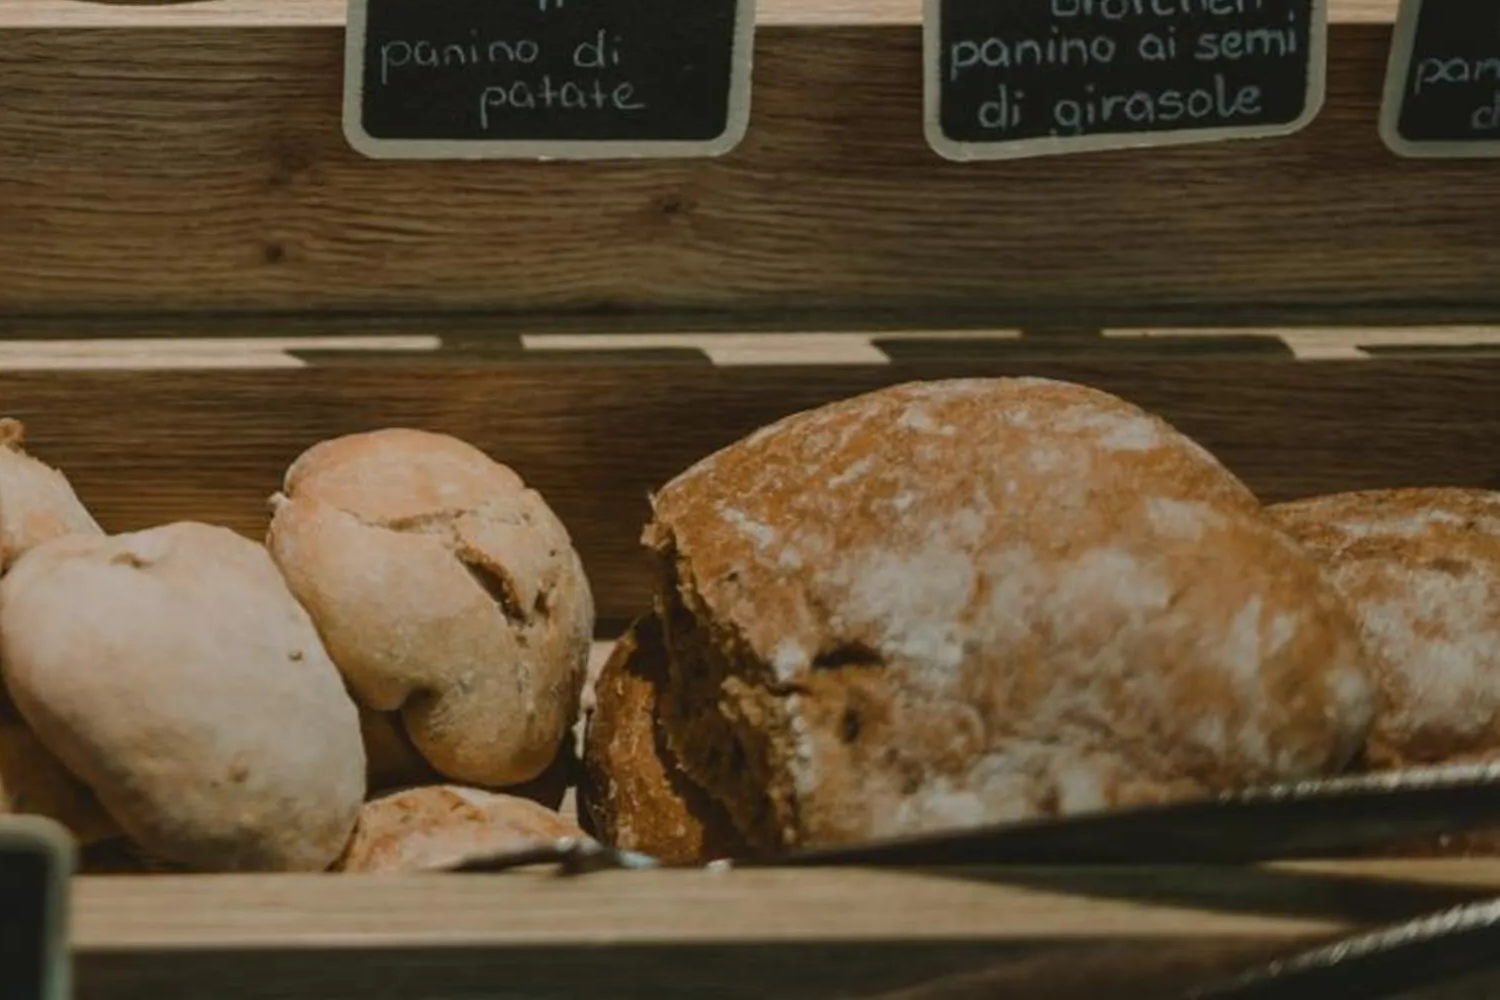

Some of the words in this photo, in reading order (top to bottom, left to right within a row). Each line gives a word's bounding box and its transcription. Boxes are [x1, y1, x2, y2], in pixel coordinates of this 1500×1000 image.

[380, 29, 539, 85] panino
[573, 29, 621, 68] di
[951, 26, 1116, 81] panino
[1138, 26, 1176, 61] ai
[1194, 12, 1297, 60] semi
[480, 75, 645, 129] patate
[977, 83, 1025, 130] di
[1050, 74, 1263, 138] girasole
